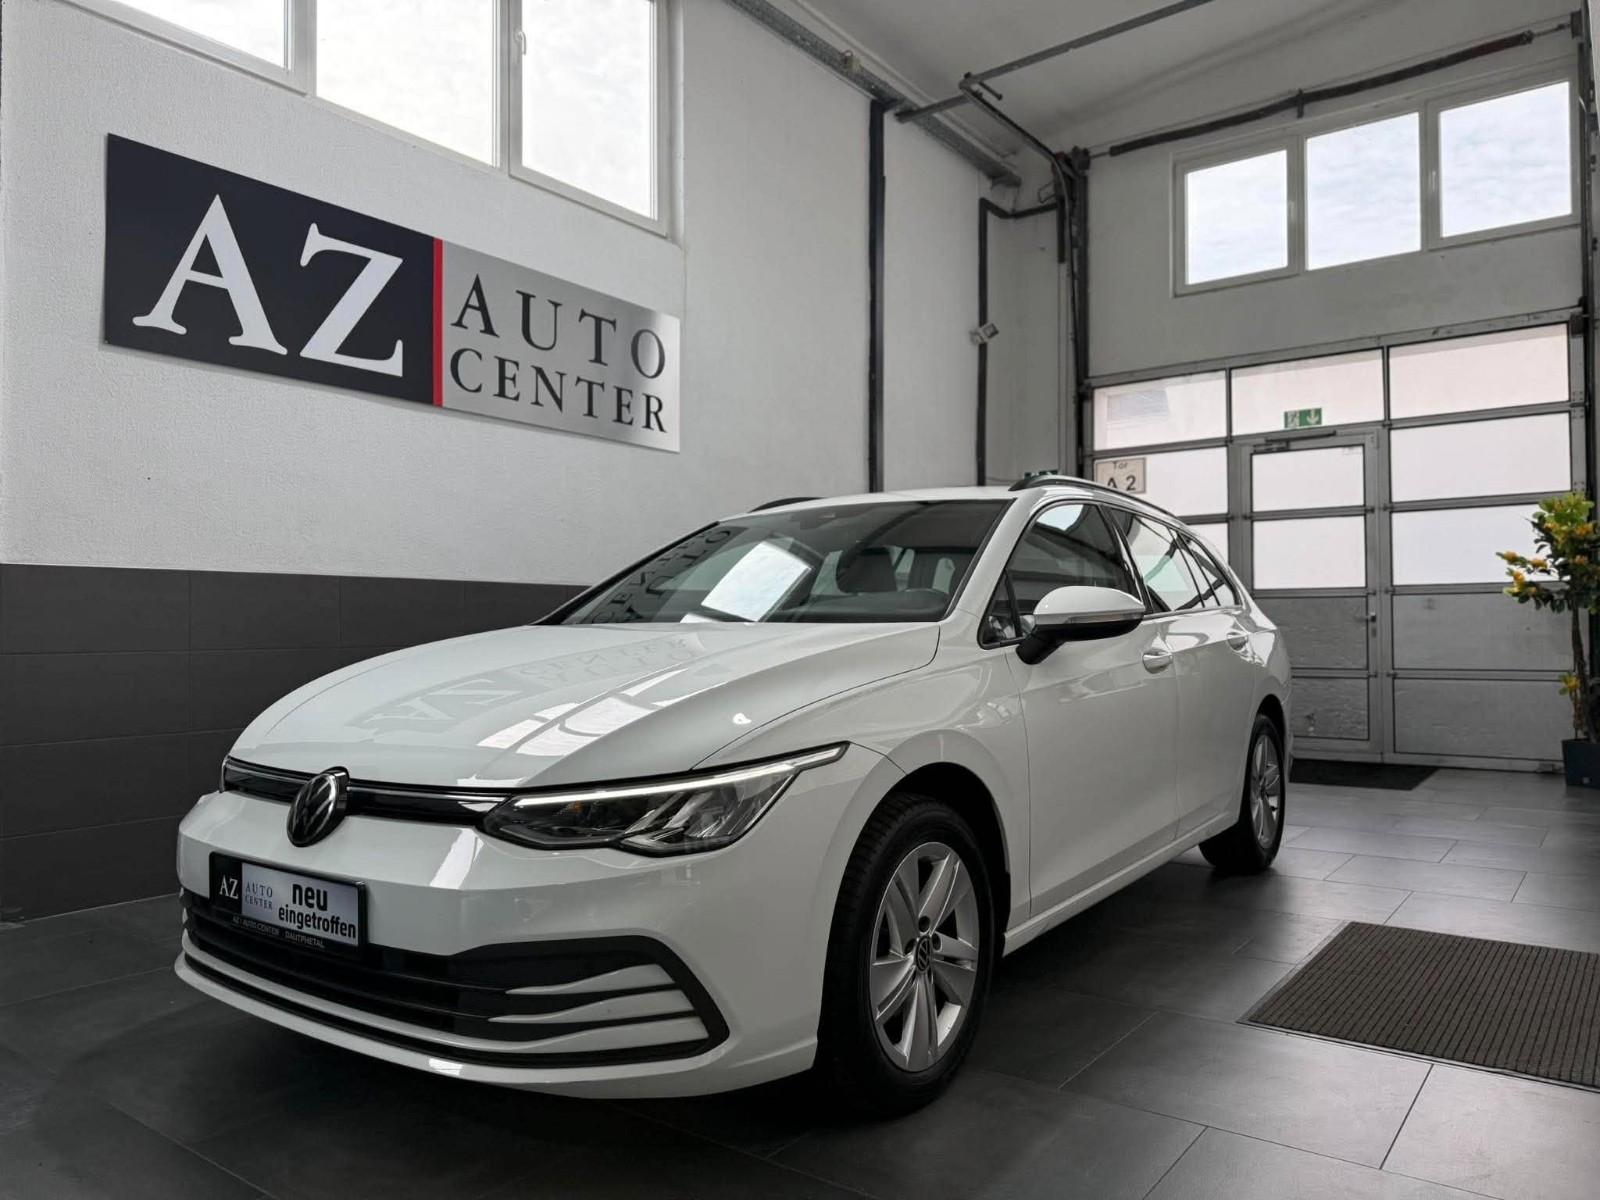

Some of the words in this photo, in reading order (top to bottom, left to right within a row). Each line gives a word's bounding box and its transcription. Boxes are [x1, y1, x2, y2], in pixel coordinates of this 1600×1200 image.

[131, 193, 404, 378] AZ
[450, 273, 667, 380] AUTO
[449, 347, 668, 434] CENTER
[1112, 461, 1128, 470] Tor
[1126, 474, 1136, 491] 2
[219, 875, 239, 899] AZ
[245, 881, 273, 898] AUTO
[292, 883, 328, 911] neu
[245, 894, 273, 910] CENTER
[278, 904, 356, 938] eingetroffen
